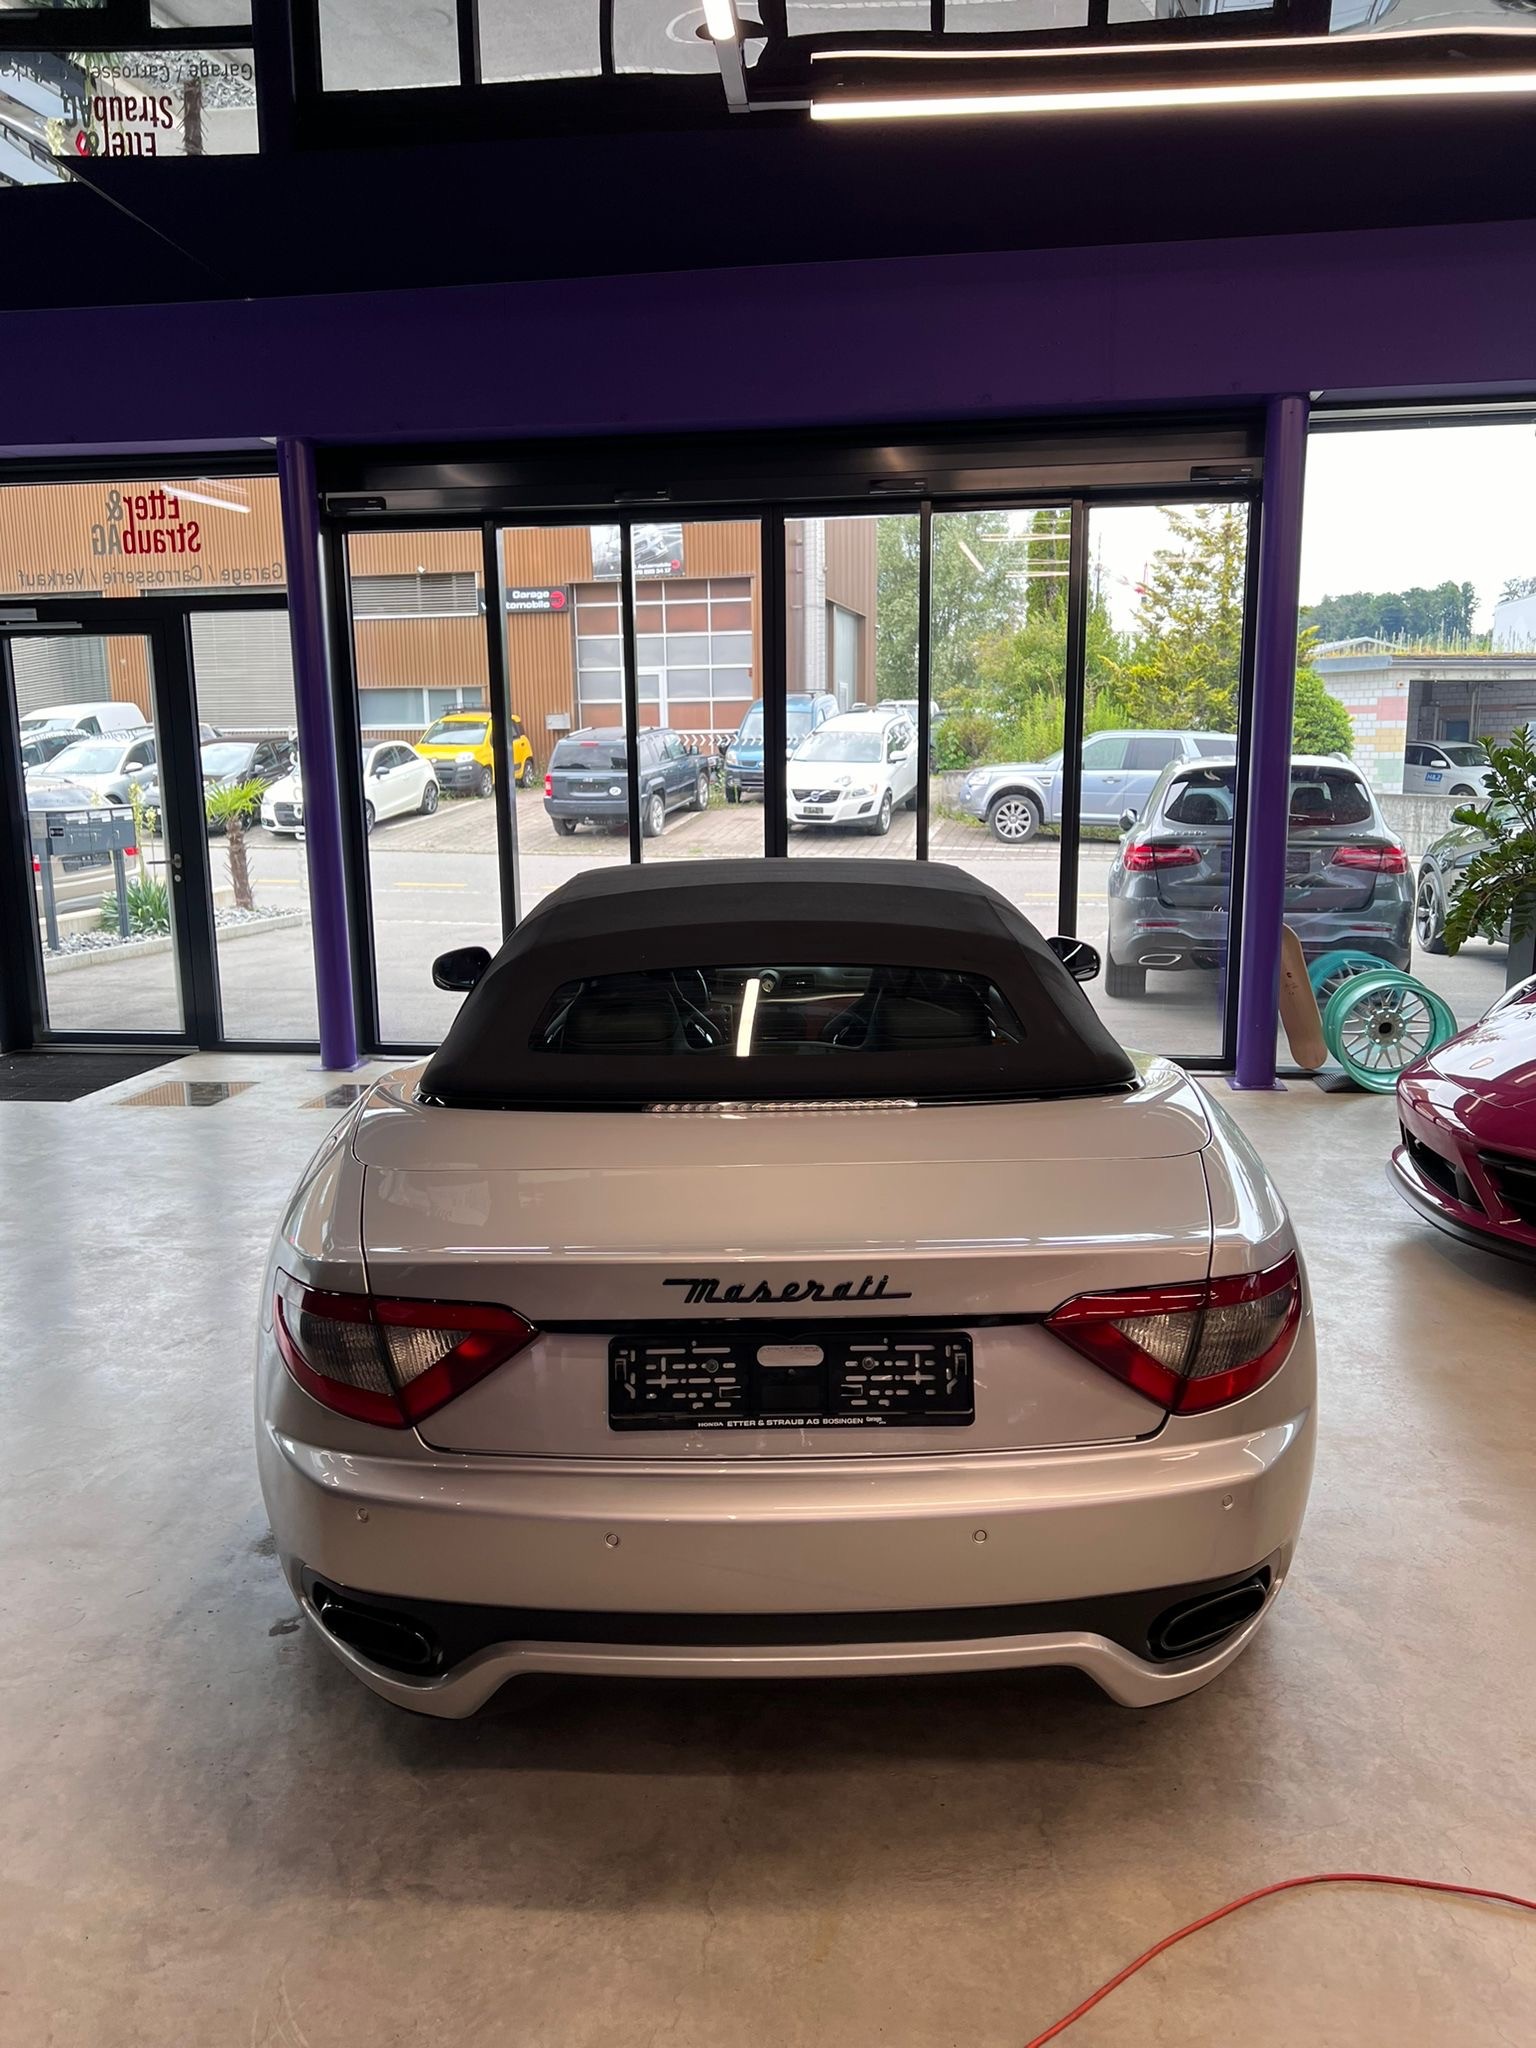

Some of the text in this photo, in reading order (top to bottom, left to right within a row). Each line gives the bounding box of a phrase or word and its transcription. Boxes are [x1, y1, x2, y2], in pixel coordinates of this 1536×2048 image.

[186, 59, 253, 81] Garage
[93, 95, 174, 129] Straub
[512, 590, 550, 600] Garage
[662, 1274, 913, 1304] Maserati
[726, 1419, 756, 1427] ETTER
[766, 1418, 805, 1426] STRAUB
[806, 1417, 820, 1425] AG
